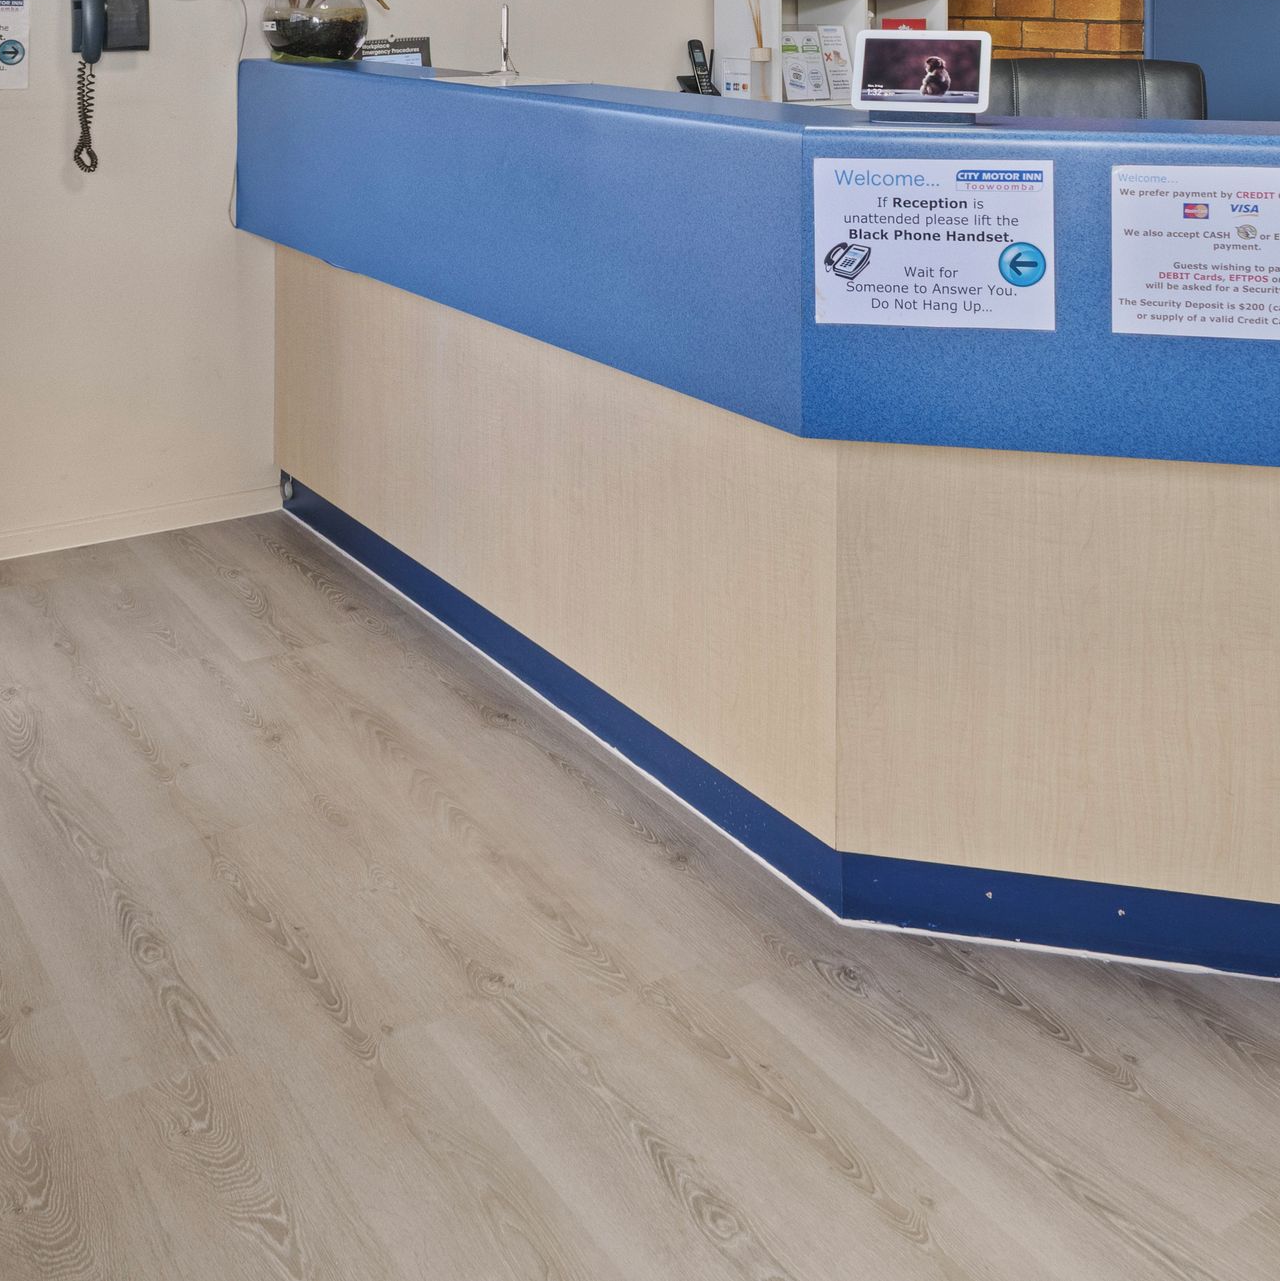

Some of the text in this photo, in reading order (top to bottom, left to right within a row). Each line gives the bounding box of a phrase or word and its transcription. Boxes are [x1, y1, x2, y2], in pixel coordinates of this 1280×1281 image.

[834, 169, 940, 187] Welcome...
[957, 172, 1042, 181] CITY MOTOR INN
[1118, 173, 1179, 184] Welcome...
[1119, 188, 1136, 196] We
[1138, 188, 1170, 197] prefer
[1172, 190, 1217, 199] payment
[1220, 190, 1233, 199] by
[1236, 191, 1275, 199] CREDIT
[877, 196, 984, 211] If Reception is
[1230, 204, 1260, 213] VISA
[844, 213, 1019, 227] unattended please lift the
[849, 228, 1014, 243] Black Phone Handset.
[1123, 228, 1140, 237] We
[1142, 229, 1164, 237] also
[1166, 230, 1200, 239] accept
[1203, 231, 1231, 239] CASH
[1213, 243, 1262, 251] payment.
[904, 266, 959, 278] Wait for
[1173, 261, 1208, 270] Guests
[1211, 262, 1252, 273] wishing
[1254, 264, 1265, 272] to
[1158, 272, 1191, 280] DEBIT
[1193, 272, 1226, 282] Cards,
[1229, 274, 1269, 283] EFTPOS
[846, 281, 1018, 297] Someone to Answer You.
[1166, 282, 1180, 290] be
[1182, 283, 1212, 291] asked
[1215, 283, 1230, 292] for
[871, 298, 993, 314] Do Not Hang Up...
[1119, 298, 1137, 306] The
[1140, 298, 1181, 309] Security
[1185, 300, 1224, 310] Deposit
[1227, 302, 1236, 310] is
[1238, 303, 1265, 312] $200
[1150, 313, 1184, 323] supply
[1186, 314, 1198, 322] of
[1209, 315, 1234, 324] valid
[1237, 316, 1269, 325] Credit
